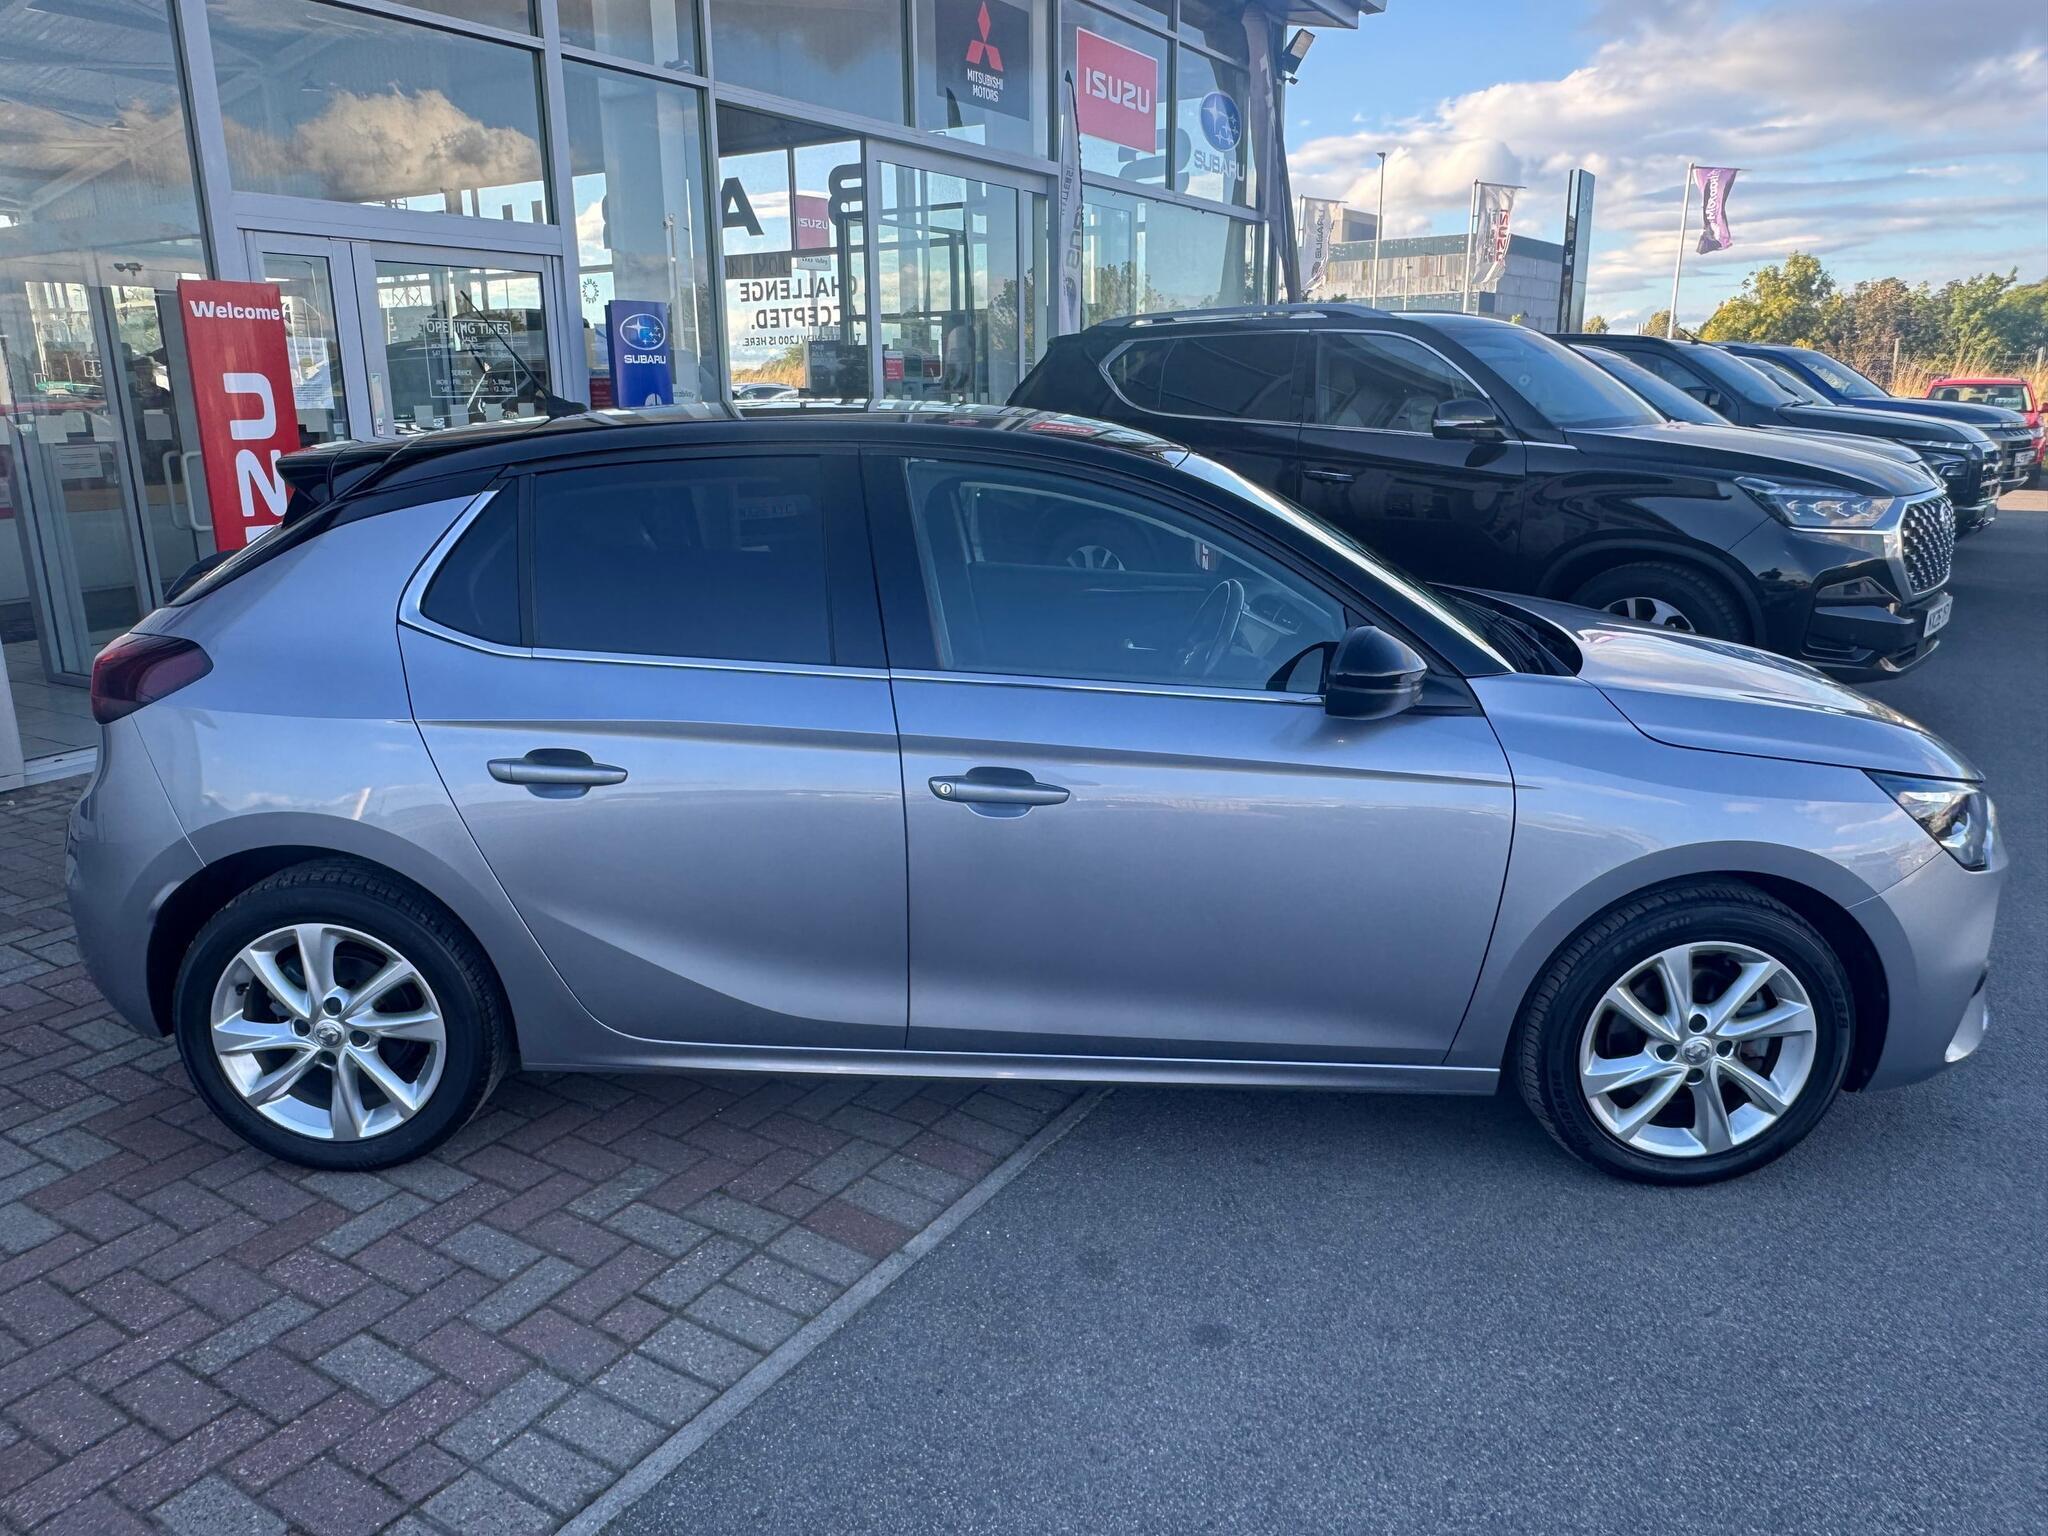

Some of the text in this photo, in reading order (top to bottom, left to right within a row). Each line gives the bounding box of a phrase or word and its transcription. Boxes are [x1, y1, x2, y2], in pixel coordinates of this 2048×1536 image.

[967, 68, 1004, 91] MITSUBISHI
[1085, 66, 1150, 114] ISUZU
[973, 84, 999, 103] MOTORS
[1194, 150, 1245, 182] SUBARU
[797, 216, 828, 230] ISUZU
[189, 300, 281, 321] Welcome
[624, 354, 667, 364] SUBARU
